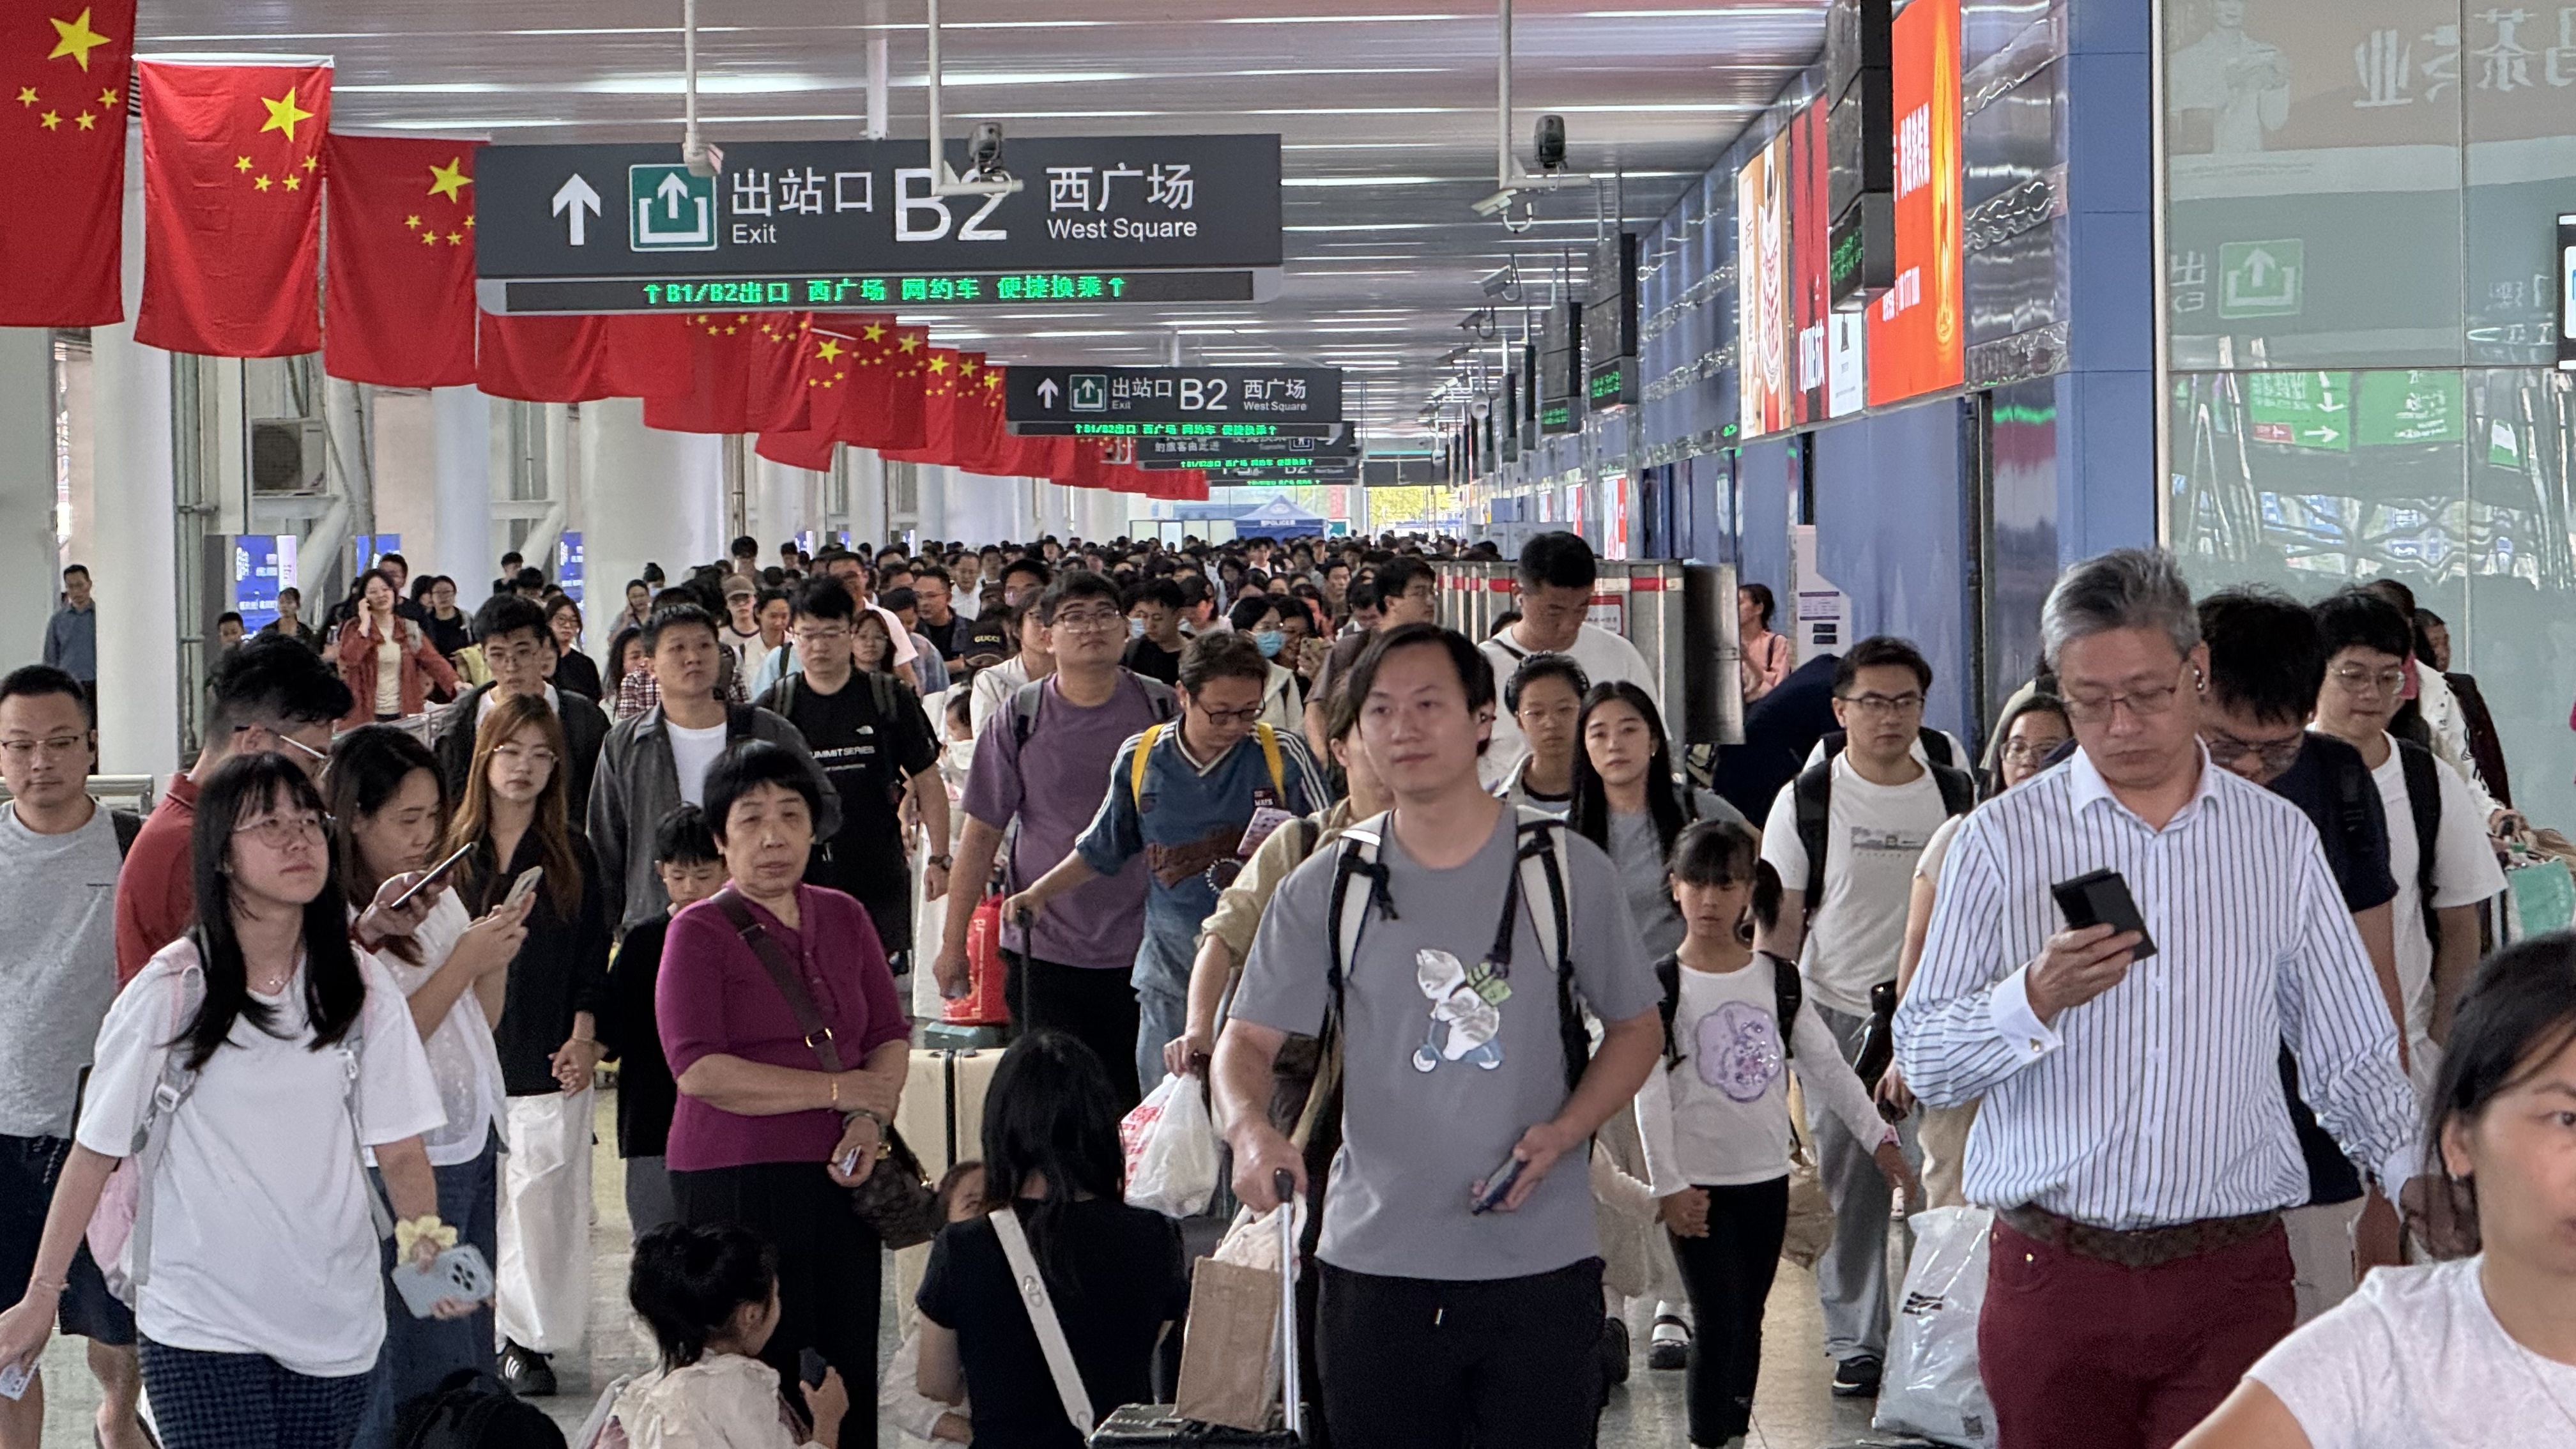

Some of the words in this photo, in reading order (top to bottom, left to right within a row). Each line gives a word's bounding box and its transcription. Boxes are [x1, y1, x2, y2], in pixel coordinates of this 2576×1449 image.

[732, 167, 873, 217] 出站口
[1046, 162, 1194, 212] 西广场
[895, 167, 1012, 242] B2
[733, 224, 777, 244] Exit
[1048, 218, 1107, 239] West
[1113, 217, 1197, 242] Square
[666, 282, 789, 303] B1/B2出口
[806, 279, 887, 302] 西广场
[901, 277, 981, 300] 网约车
[1112, 377, 1172, 398] 出站口
[1180, 378, 1228, 410] B2
[1243, 378, 1306, 399] 西广场
[1112, 401, 1131, 410] Exit
[1243, 401, 1269, 411] West
[1271, 401, 1307, 412] Square
[974, 634, 1000, 643] GUCCI
[807, 748, 843, 760] UMMIT
